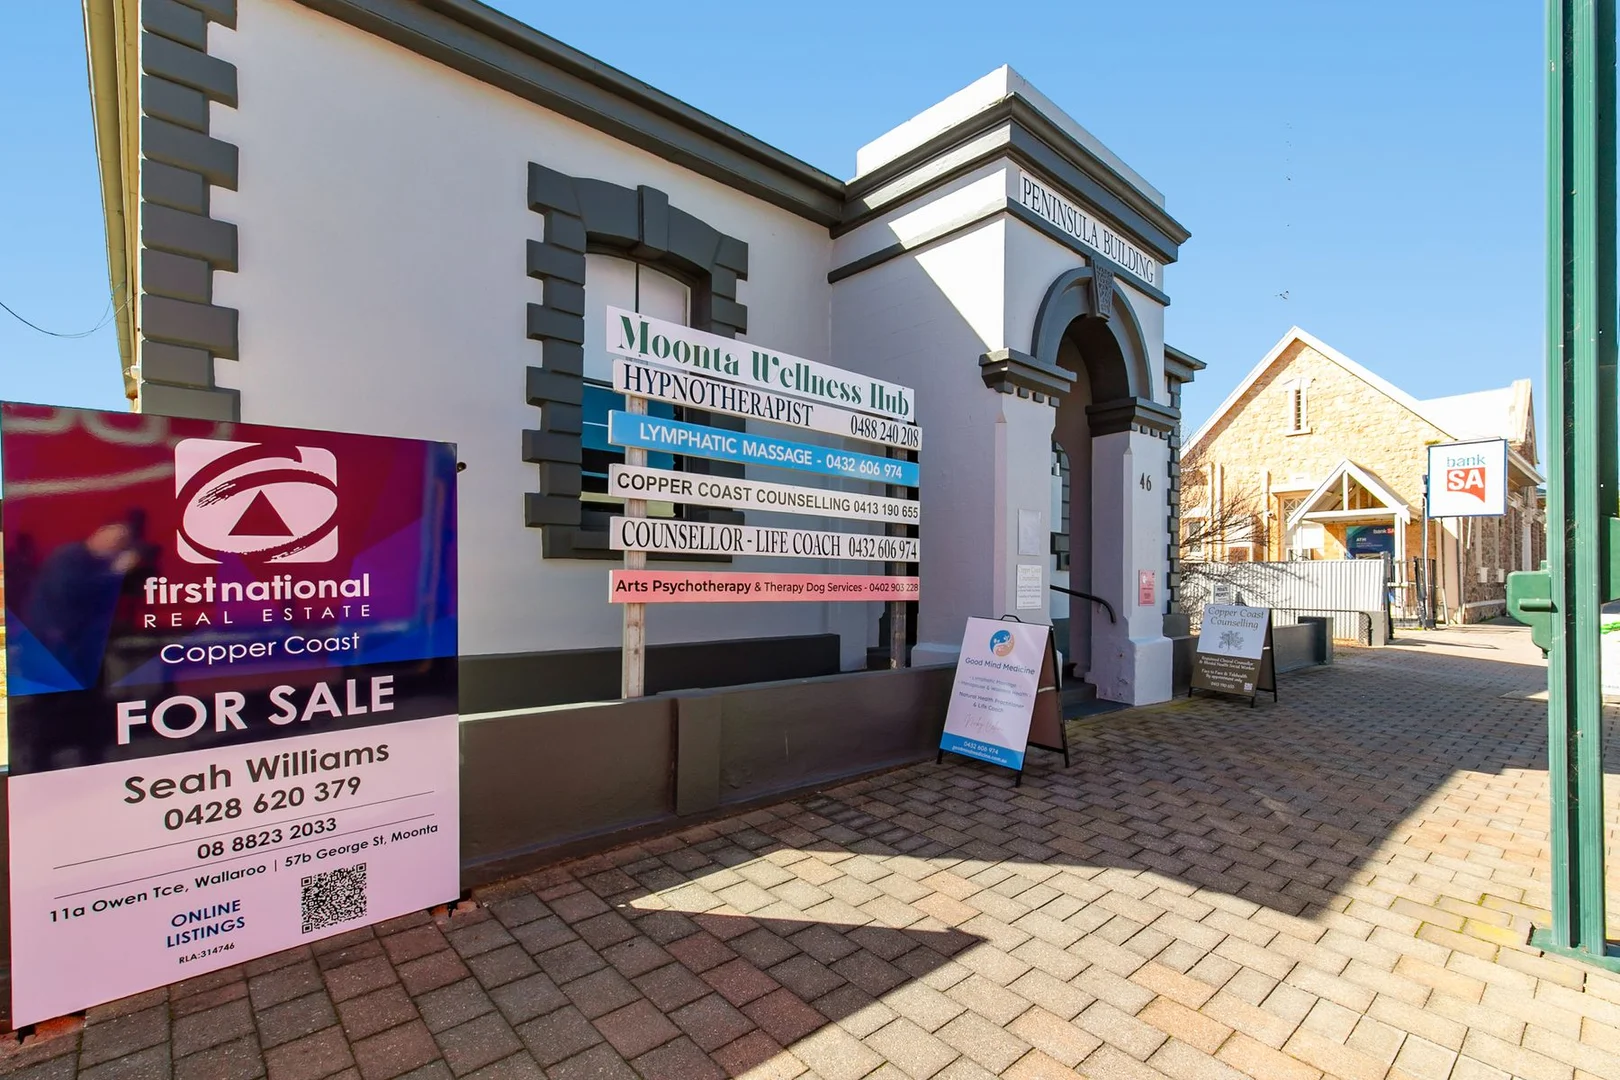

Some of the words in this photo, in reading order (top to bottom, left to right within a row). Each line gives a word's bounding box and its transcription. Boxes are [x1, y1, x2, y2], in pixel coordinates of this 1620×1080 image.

[1022, 176, 1099, 249] PENINSULA
[1103, 228, 1154, 282] BUILDING
[618, 314, 740, 375] Moonta
[751, 349, 862, 404] Wellness
[870, 382, 909, 416] Hub
[623, 364, 813, 426] HYPNOTHERAPIST
[850, 417, 878, 440] 0488
[880, 423, 898, 444] 240
[901, 426, 918, 448] 208
[640, 422, 737, 454] LYMPHATIC
[742, 440, 812, 466] MASSAGE
[826, 454, 855, 472] 0432
[859, 460, 880, 476] 606
[883, 464, 902, 480] 974
[1446, 454, 1486, 468] bank
[617, 472, 693, 496] COPPER
[698, 482, 752, 502] COAST
[756, 489, 850, 512] COUNSELLING
[854, 501, 879, 516] 0413
[882, 504, 899, 518] 190
[902, 506, 919, 519] 655
[1140, 472, 1152, 492] 46
[1448, 469, 1484, 491] SA
[622, 520, 744, 552] COUNSELLOR
[756, 530, 788, 554] LIFE
[793, 532, 841, 558] COACH
[849, 536, 876, 559] 0432
[877, 538, 897, 560] 606
[898, 540, 917, 560] 974
[616, 579, 648, 593] Arts
[652, 579, 752, 596] Psychotherapy
[754, 582, 762, 592] &
[764, 582, 804, 596] Therapy
[806, 582, 825, 595] Dog
[828, 582, 862, 593] Services
[869, 583, 889, 593] 0402
[890, 583, 905, 593] 903
[906, 583, 919, 593] 228
[144, 611, 233, 628] REAL
[262, 604, 370, 622] ESTATE
[1208, 606, 1238, 618] Copper
[1240, 609, 1264, 619] Coast
[1210, 616, 1258, 631] Counselling
[160, 641, 277, 665] Copper
[284, 632, 360, 655] Coast
[965, 656, 983, 667] Good
[984, 660, 1001, 670] Mind
[1002, 664, 1036, 676] Medicine
[117, 691, 246, 745] FOR
[268, 675, 395, 725] SALE
[963, 741, 977, 750] 0432
[124, 764, 231, 804] Seah
[246, 742, 390, 783] Williams
[164, 796, 242, 830] 0428
[253, 786, 304, 814] 620
[314, 776, 362, 802] 379
[197, 842, 224, 860] 08
[232, 829, 283, 853] 8823
[290, 818, 337, 840] 2033
[50, 905, 85, 923] 11a
[92, 891, 148, 914] Owen
[153, 881, 190, 900] Tce,
[194, 862, 266, 889] Wallaroo
[285, 852, 312, 868] 57b
[316, 840, 369, 862] George
[373, 834, 387, 848] St,
[391, 824, 438, 843] Moonta
[170, 900, 241, 928] ONLINE
[166, 916, 246, 948] LISTINGS
[178, 942, 236, 965] RLA:314746
